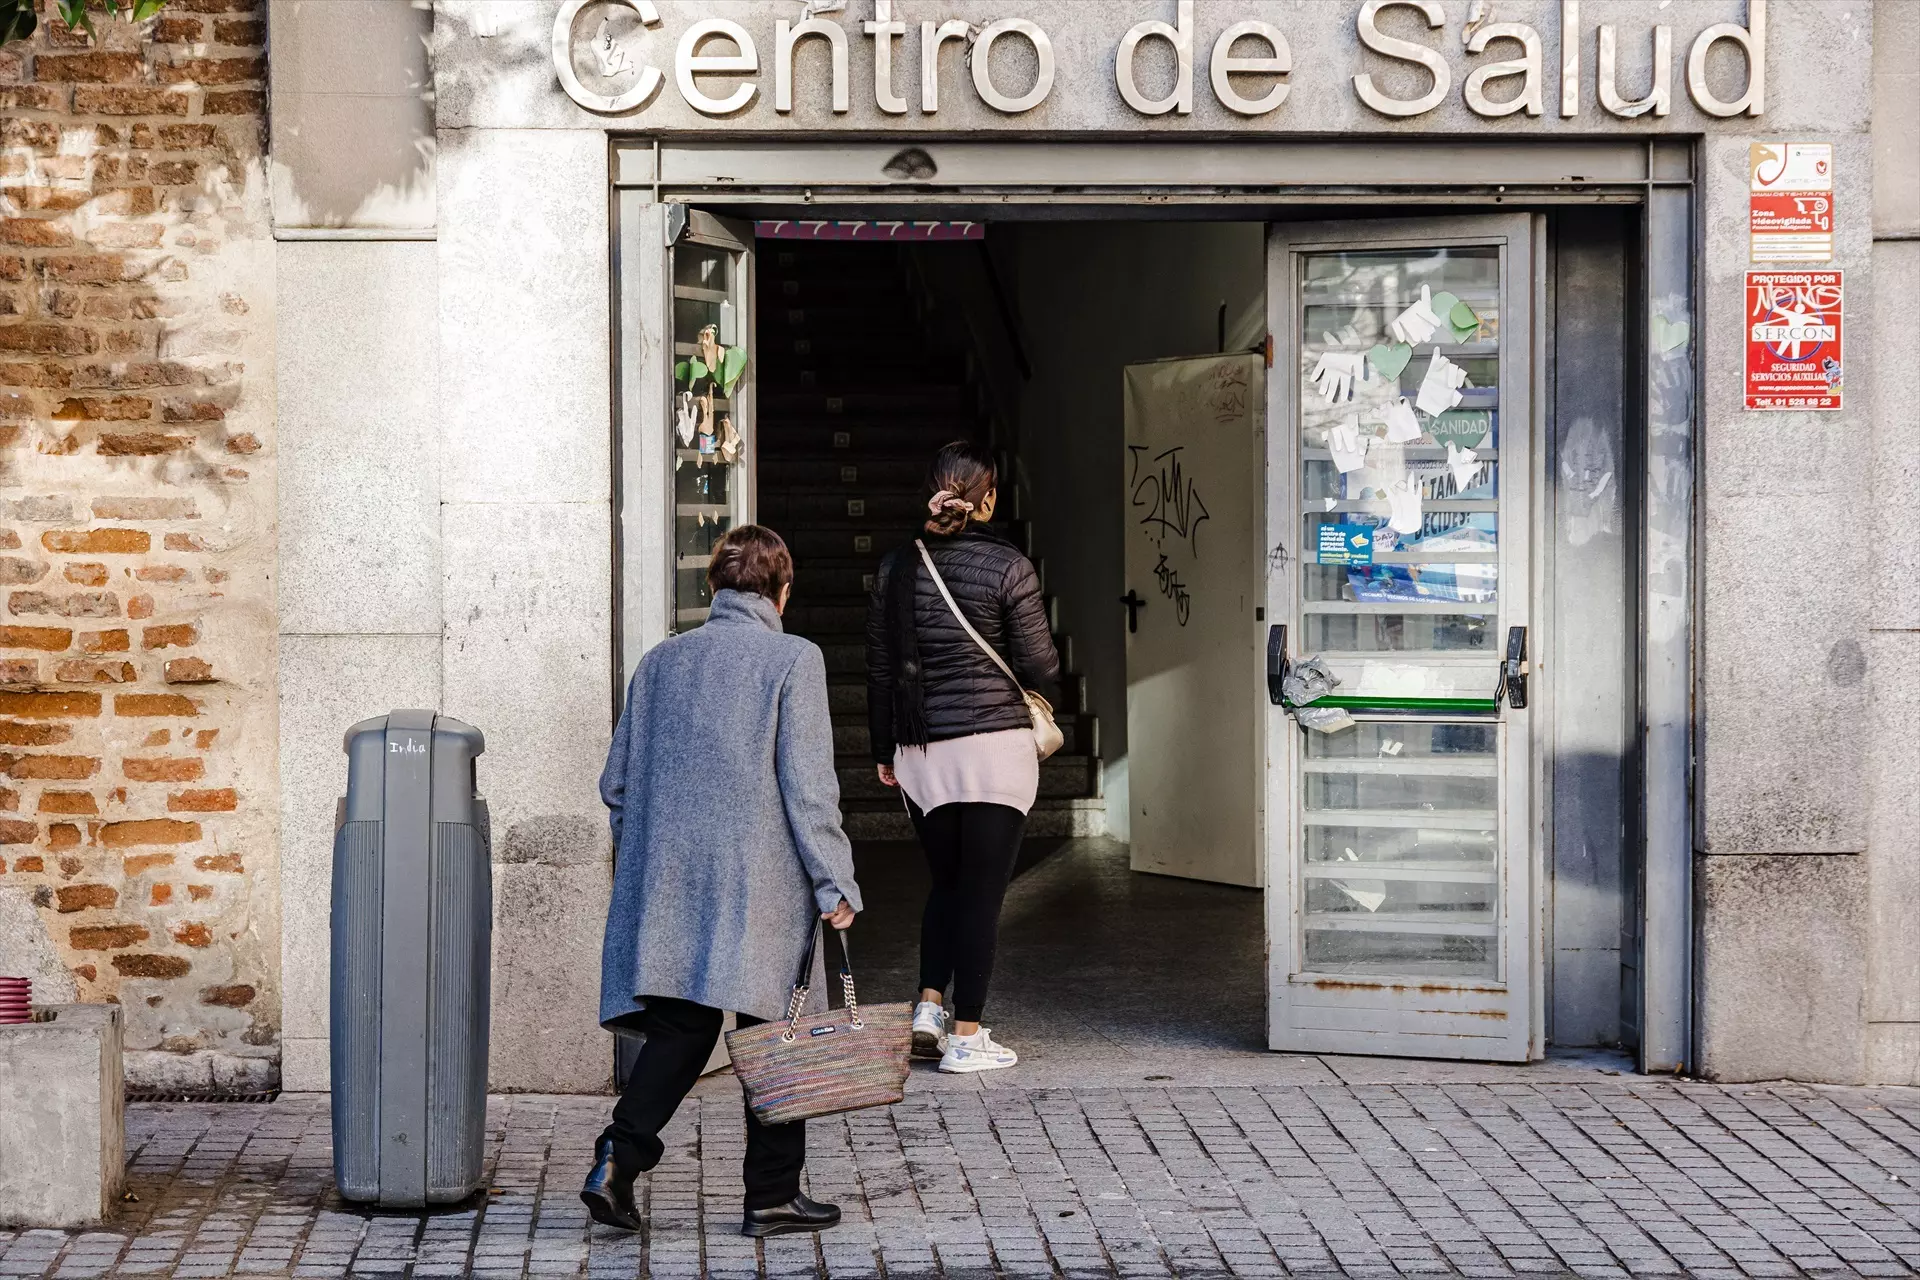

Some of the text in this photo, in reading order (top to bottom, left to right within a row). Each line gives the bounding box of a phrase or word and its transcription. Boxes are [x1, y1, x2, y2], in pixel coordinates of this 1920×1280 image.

[552, 0, 1767, 118] Centro de Salud
[1752, 217, 1812, 226] videovigilada
[1752, 274, 1836, 284] PROTEGIDO POR
[1754, 327, 1833, 340] SERCON
[1771, 362, 1817, 372] SEGURIDAD
[1751, 372, 1792, 381] SERVICIOS
[1430, 419, 1488, 435] SANIDAD
[389, 737, 426, 754] India
